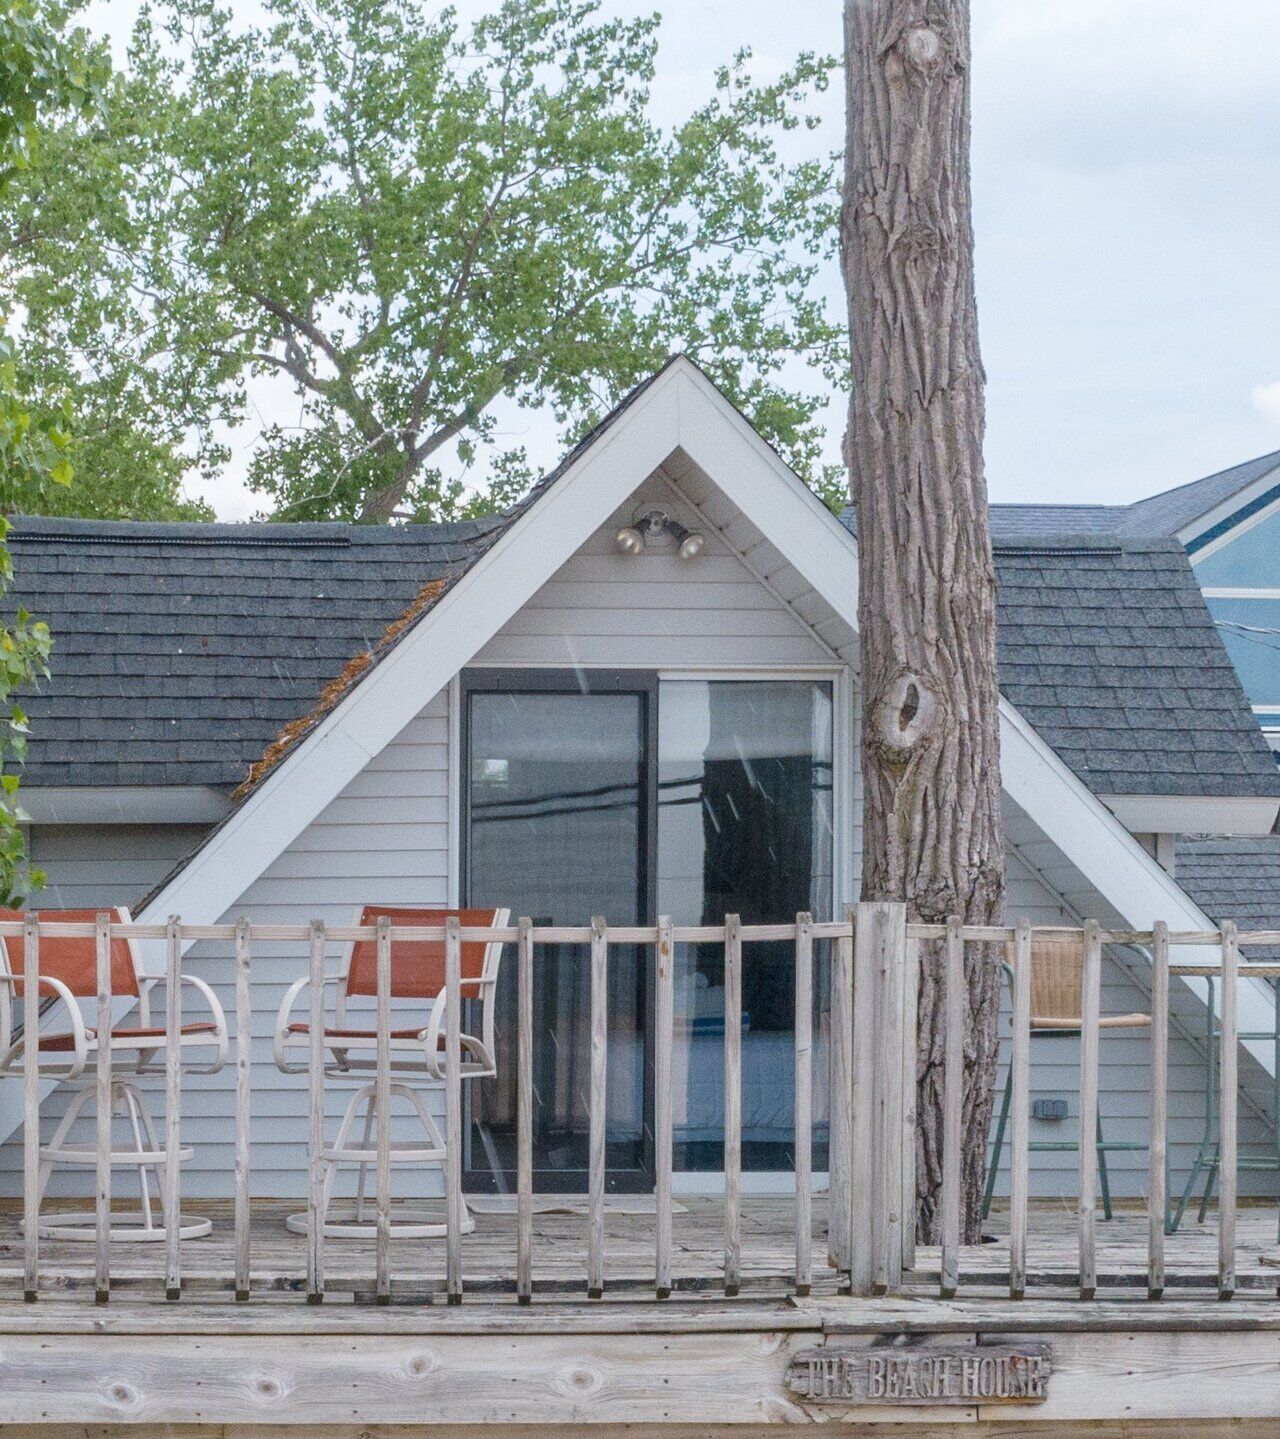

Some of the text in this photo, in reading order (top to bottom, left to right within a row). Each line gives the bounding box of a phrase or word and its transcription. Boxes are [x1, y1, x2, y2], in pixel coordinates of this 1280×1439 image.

[806, 1356, 1043, 1398] THE BEACH HOUSE
